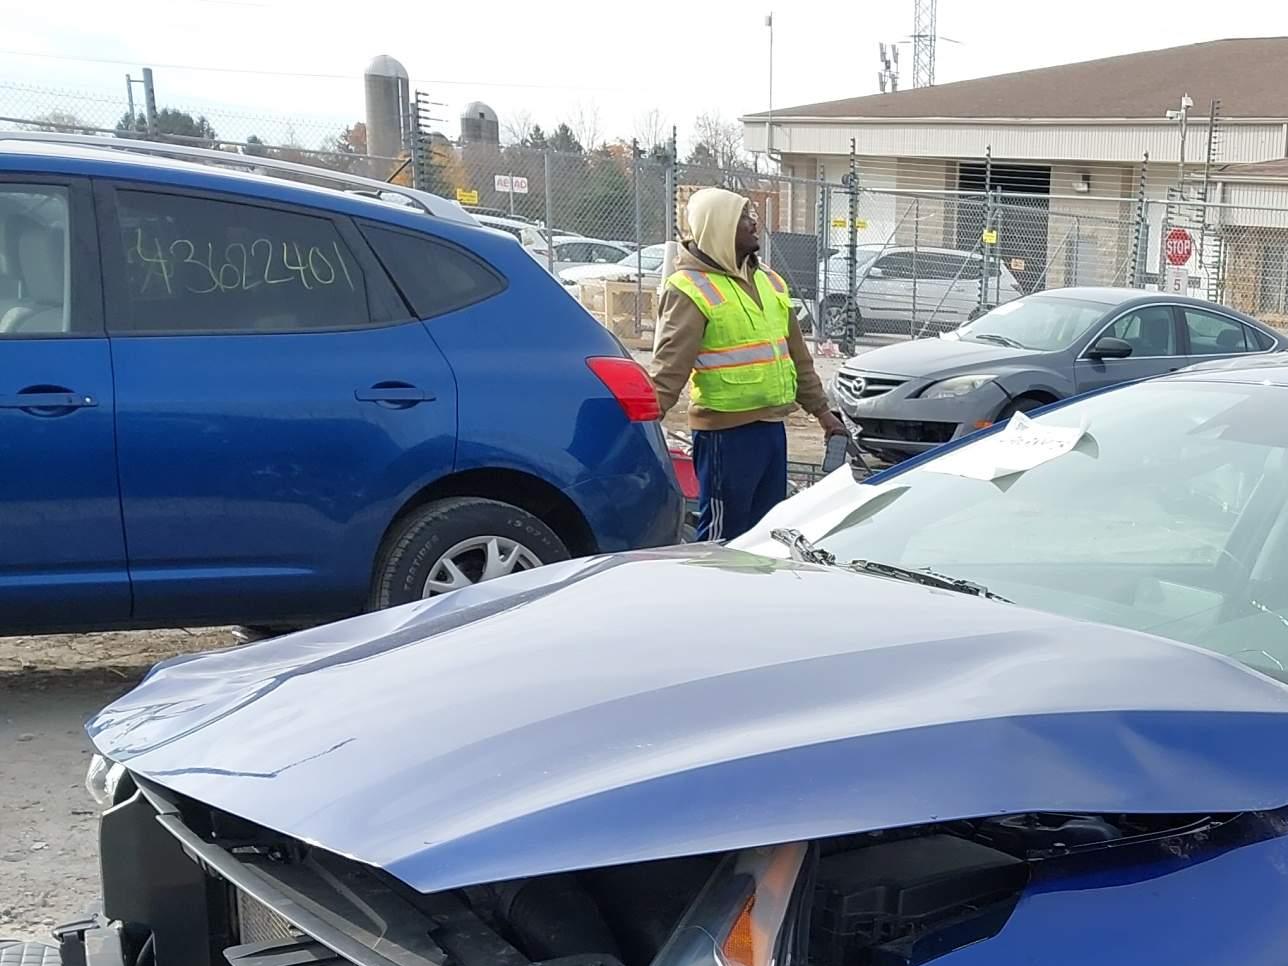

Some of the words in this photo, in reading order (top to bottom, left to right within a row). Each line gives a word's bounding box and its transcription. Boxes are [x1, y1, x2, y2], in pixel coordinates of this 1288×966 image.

[1167, 239, 1191, 255] STOP
[136, 227, 354, 294] 43622401
[1174, 279, 1181, 291] 5
